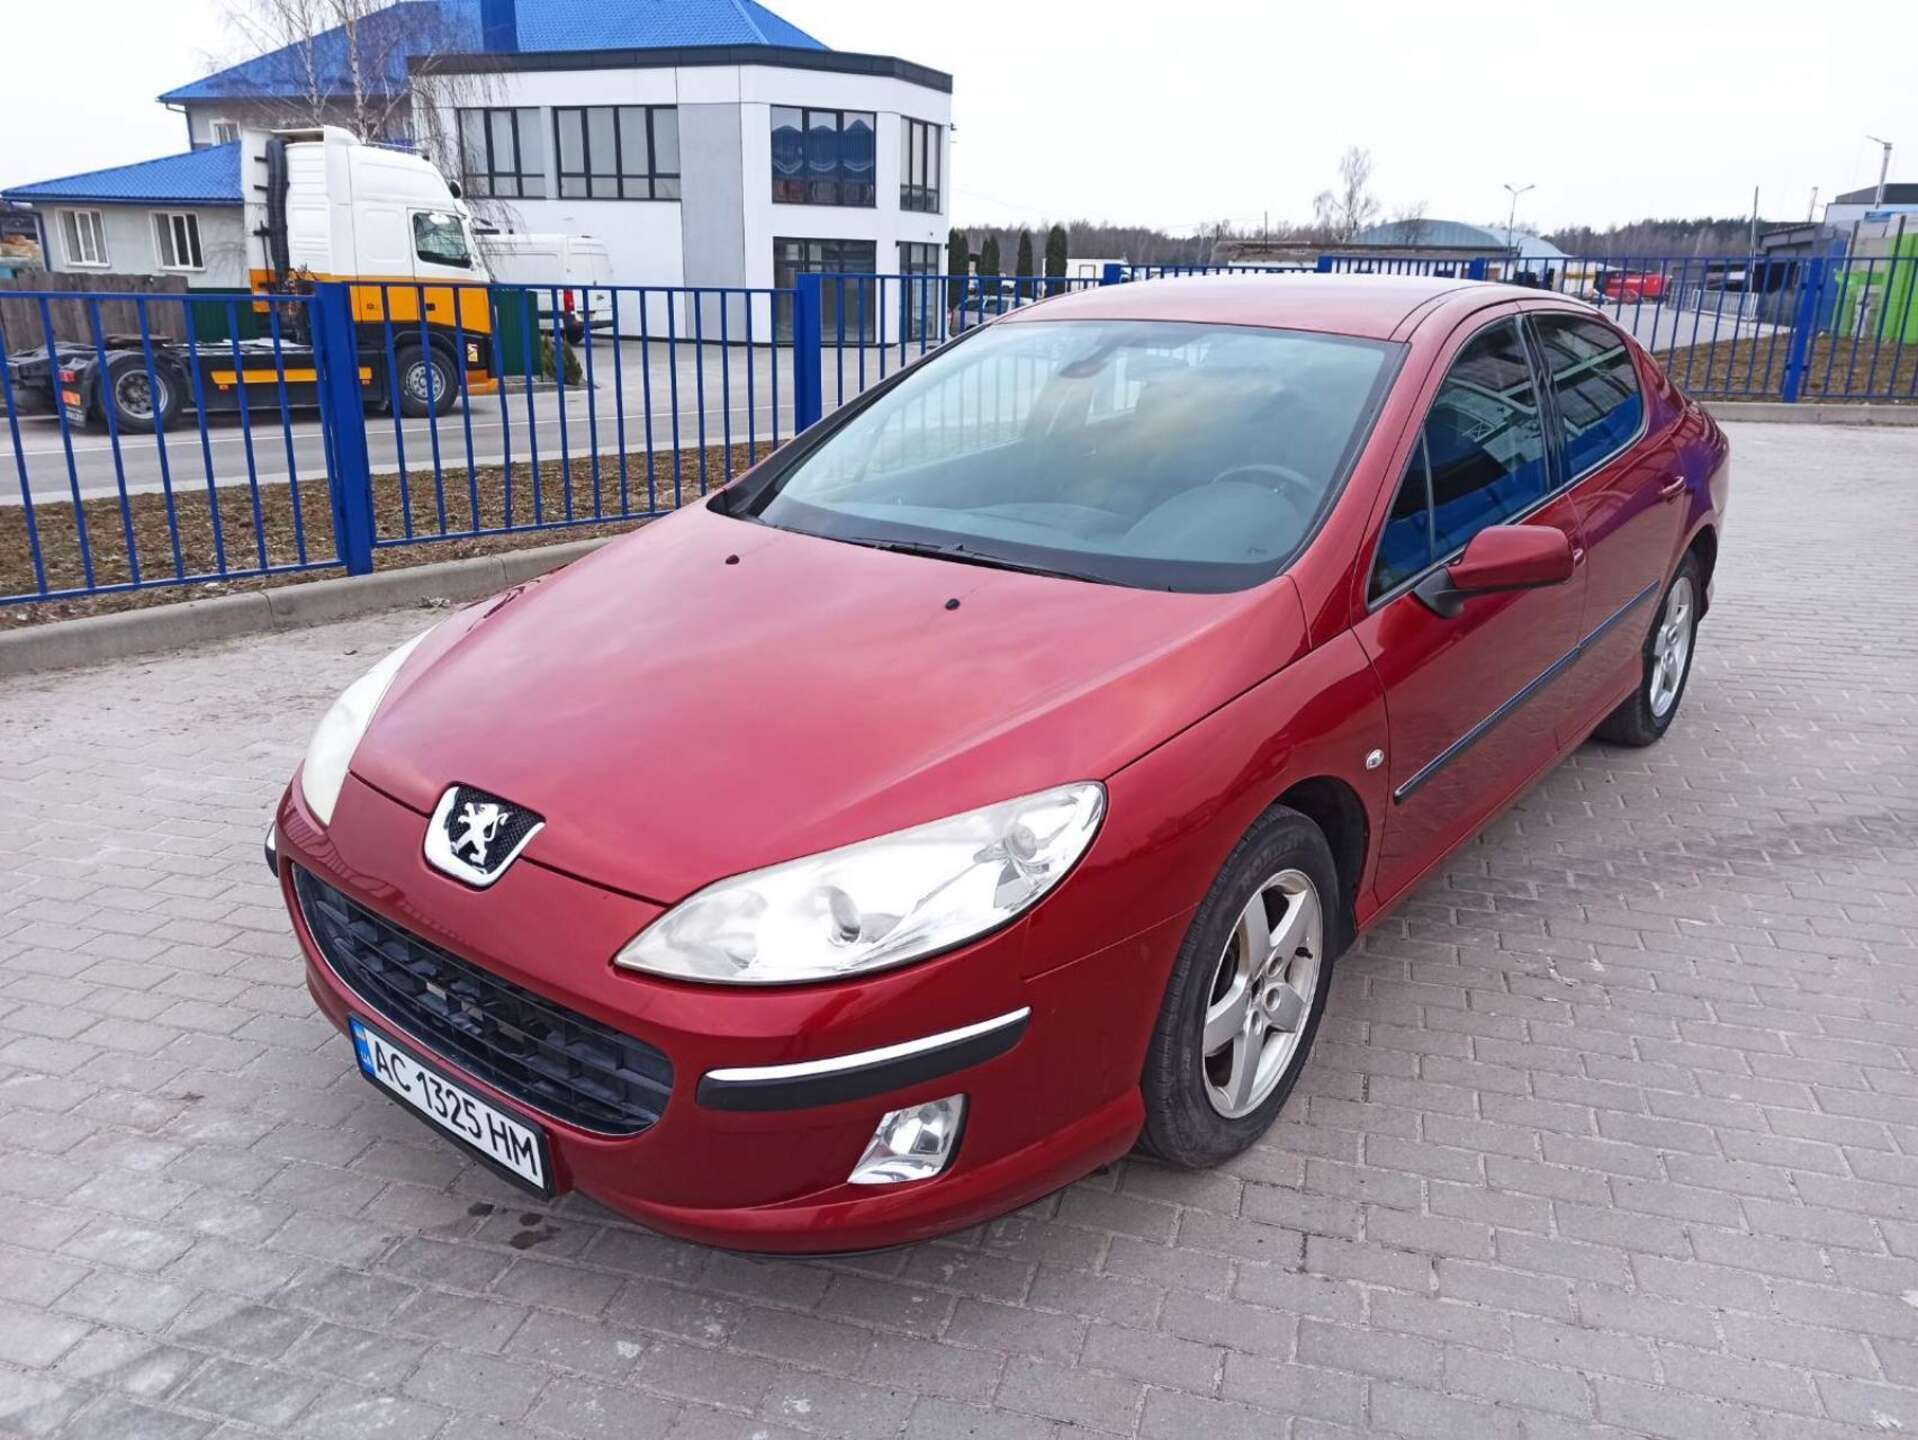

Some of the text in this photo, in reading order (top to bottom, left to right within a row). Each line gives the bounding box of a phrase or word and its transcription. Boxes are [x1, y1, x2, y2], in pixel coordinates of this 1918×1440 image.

[375, 1041, 537, 1176] AC 1325 HM
